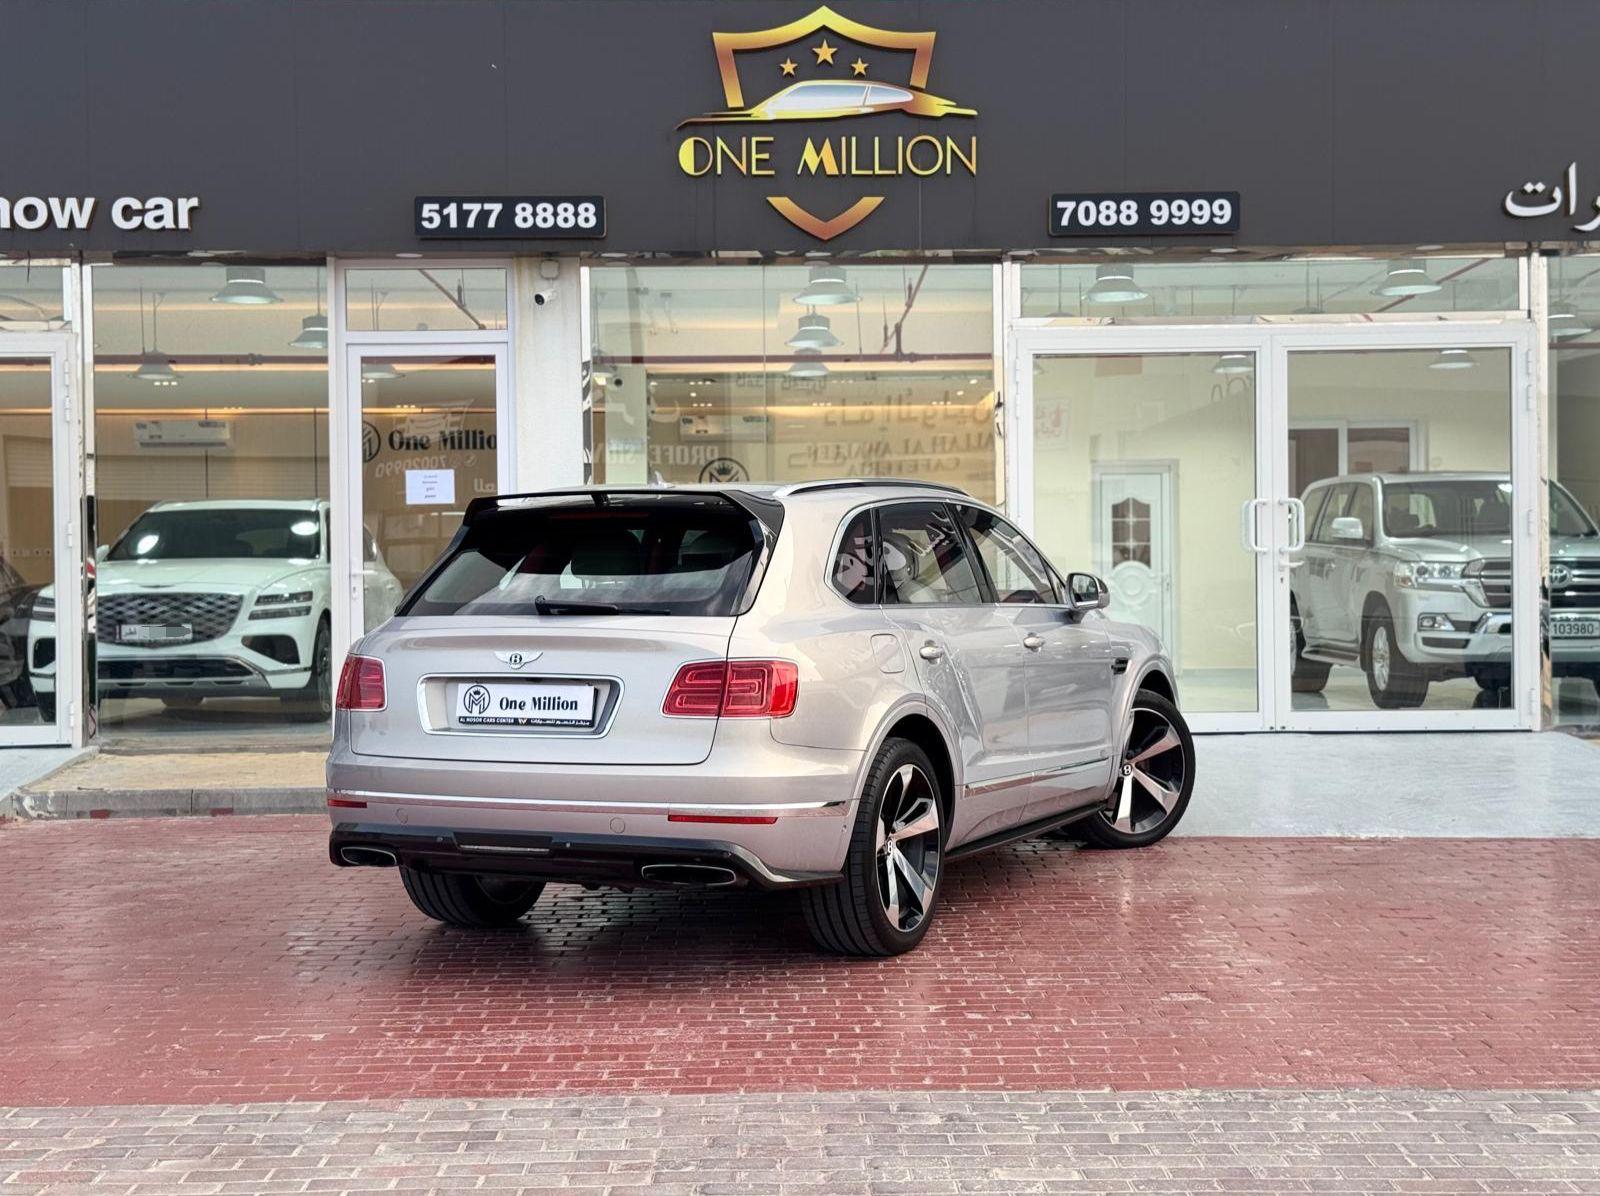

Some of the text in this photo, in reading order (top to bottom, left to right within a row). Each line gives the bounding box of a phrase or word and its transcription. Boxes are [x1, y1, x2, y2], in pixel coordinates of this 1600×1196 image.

[678, 135, 977, 176] ONE MILLION
[111, 196, 199, 230] car
[421, 202, 597, 229] 5177 8888
[1056, 198, 1232, 227] 7088 9999
[388, 429, 431, 451] One
[1553, 623, 1594, 635] 103980
[499, 696, 578, 711] One Million
